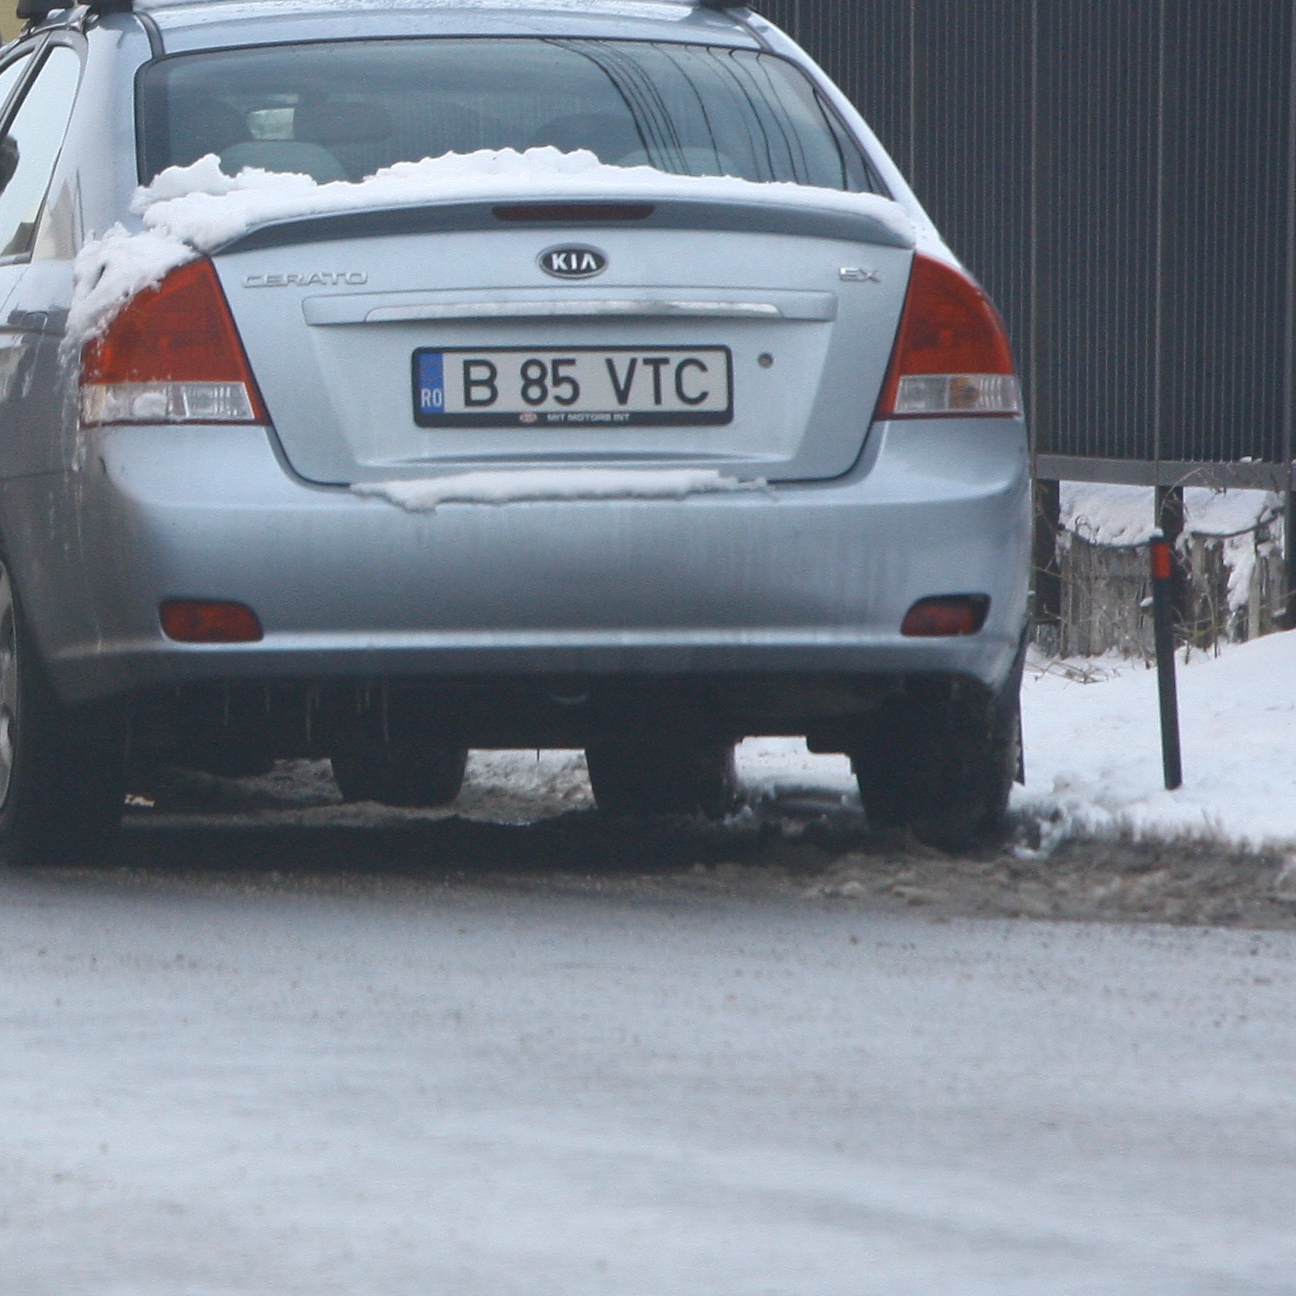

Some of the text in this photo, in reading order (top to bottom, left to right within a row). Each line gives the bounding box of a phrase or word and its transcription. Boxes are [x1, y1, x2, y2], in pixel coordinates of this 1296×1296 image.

[551, 252, 597, 271] KIA
[242, 272, 368, 288] CERATO
[839, 267, 881, 283] EX
[420, 357, 709, 408] RO B 85 VTC
